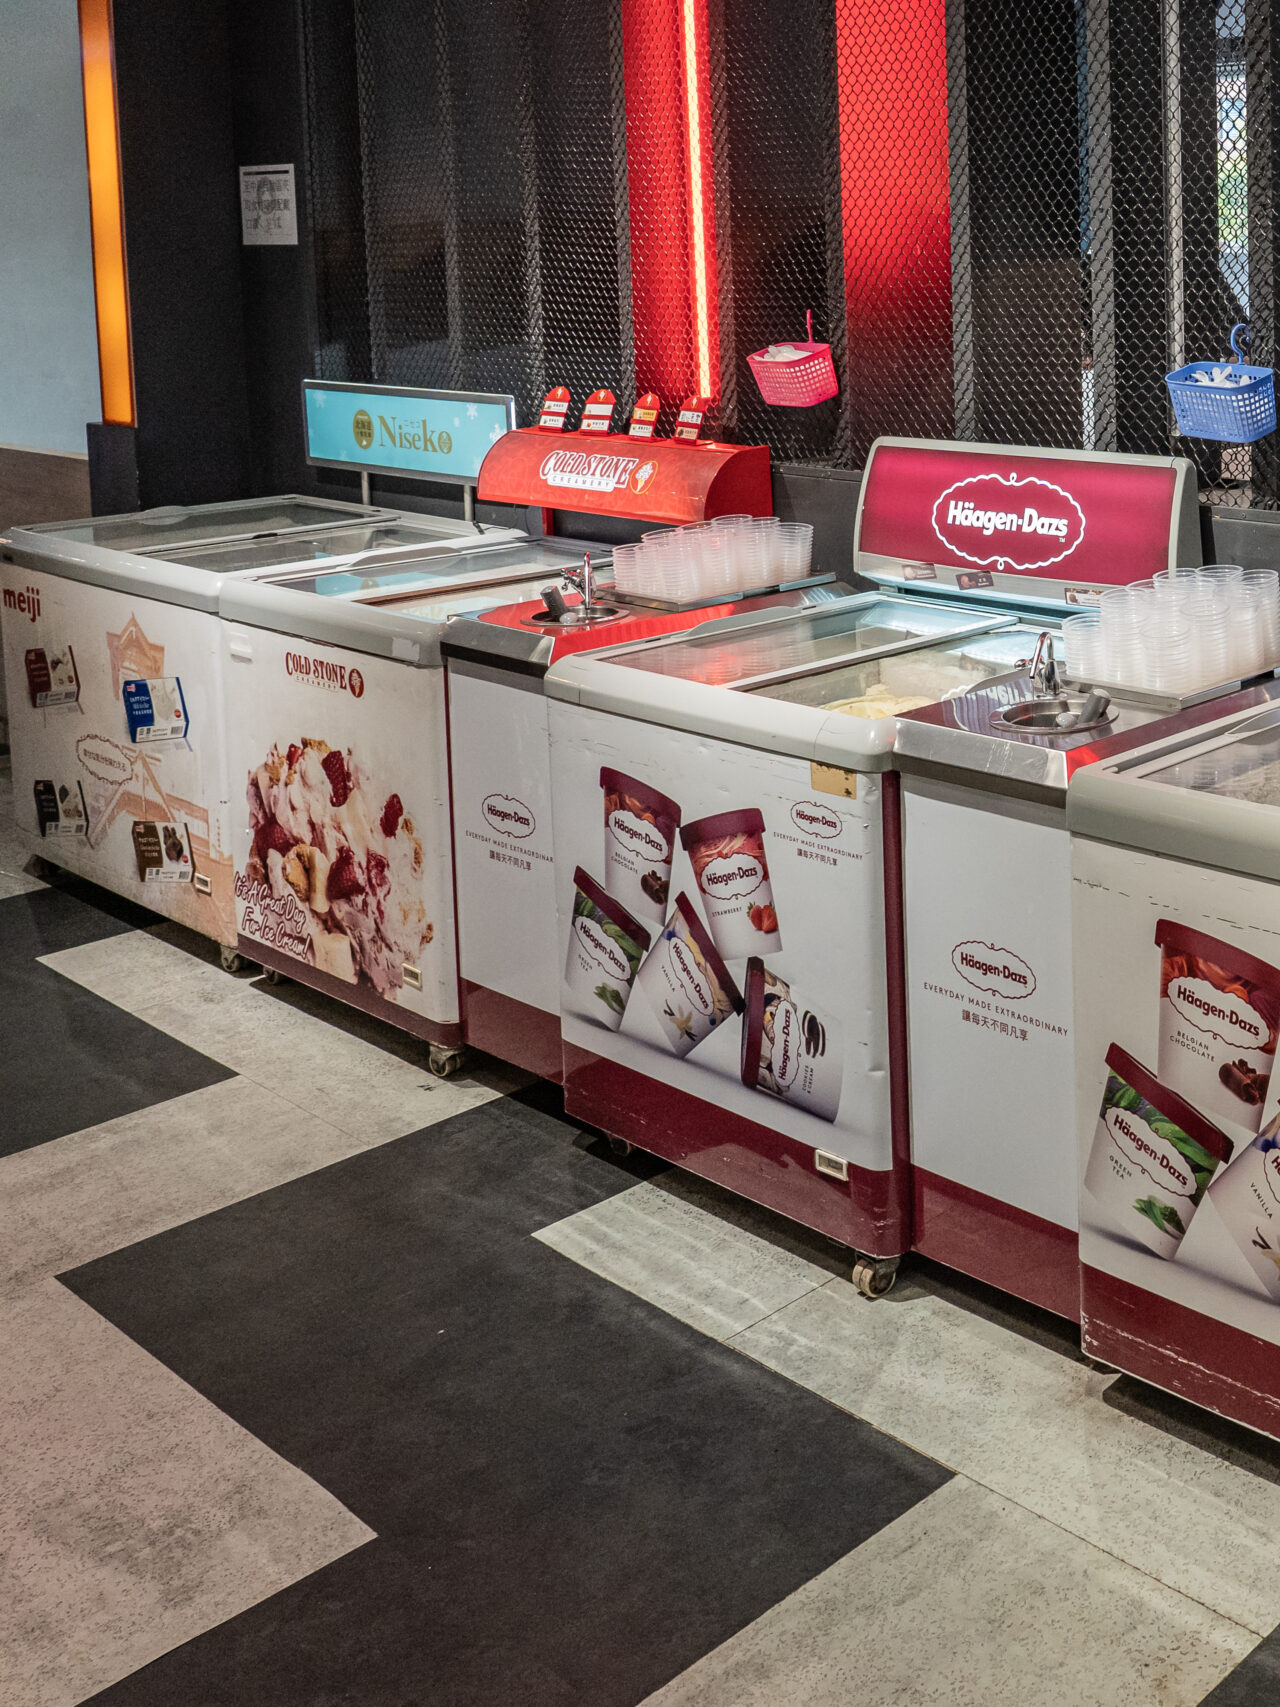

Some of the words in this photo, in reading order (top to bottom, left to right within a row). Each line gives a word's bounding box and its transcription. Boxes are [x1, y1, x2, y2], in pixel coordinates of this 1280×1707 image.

[378, 415, 453, 455] Niseko
[540, 451, 585, 478] COLD
[583, 455, 638, 488] STONE
[552, 475, 610, 487] CREAMERY
[947, 500, 1068, 537] Häagen-Dazs
[3, 586, 41, 623] meiji
[285, 652, 311, 675] COLD
[313, 659, 347, 690] STONE
[487, 803, 530, 826] Häagen-Dazs
[795, 809, 837, 829] Häagen-Dazs
[465, 830, 491, 843] EVERYDAY
[510, 844, 554, 862] EXTRAORDINAR
[614, 816, 663, 852] Häagen-Dazs
[773, 831, 799, 843] EVERYDAY
[817, 843, 863, 860] EXTRAORDINARY
[706, 866, 758, 886] Häagen-Dazs
[257, 882, 286, 916] Great
[285, 893, 306, 935] Day
[711, 906, 742, 918] STRAWBERRY
[242, 906, 260, 934] For
[259, 914, 275, 942] Ice
[275, 926, 311, 960] Cream!
[580, 921, 626, 973] Häagen-Dazs
[673, 942, 709, 1010] Häagen-Dazs
[960, 952, 1028, 986] Häagen-Dazs
[923, 982, 965, 1002] EVERYDAY
[968, 997, 991, 1011] MADE
[995, 1005, 1069, 1037] EXTRAORDINARY
[961, 1009, 1029, 1041] 讓每天不同凡享
[1177, 984, 1260, 1037] Häagen-Dazs
[778, 1008, 791, 1081] Häagen-Dazs
[1169, 1035, 1215, 1062] CHOCOLATE
[1177, 1030, 1209, 1051] BELGIAN
[1109, 1154, 1133, 1177] GREEN
[1113, 1113, 1188, 1186] Häagen-Dazs
[1112, 1165, 1125, 1180] TEA
[1250, 1182, 1273, 1220] VANILLA
